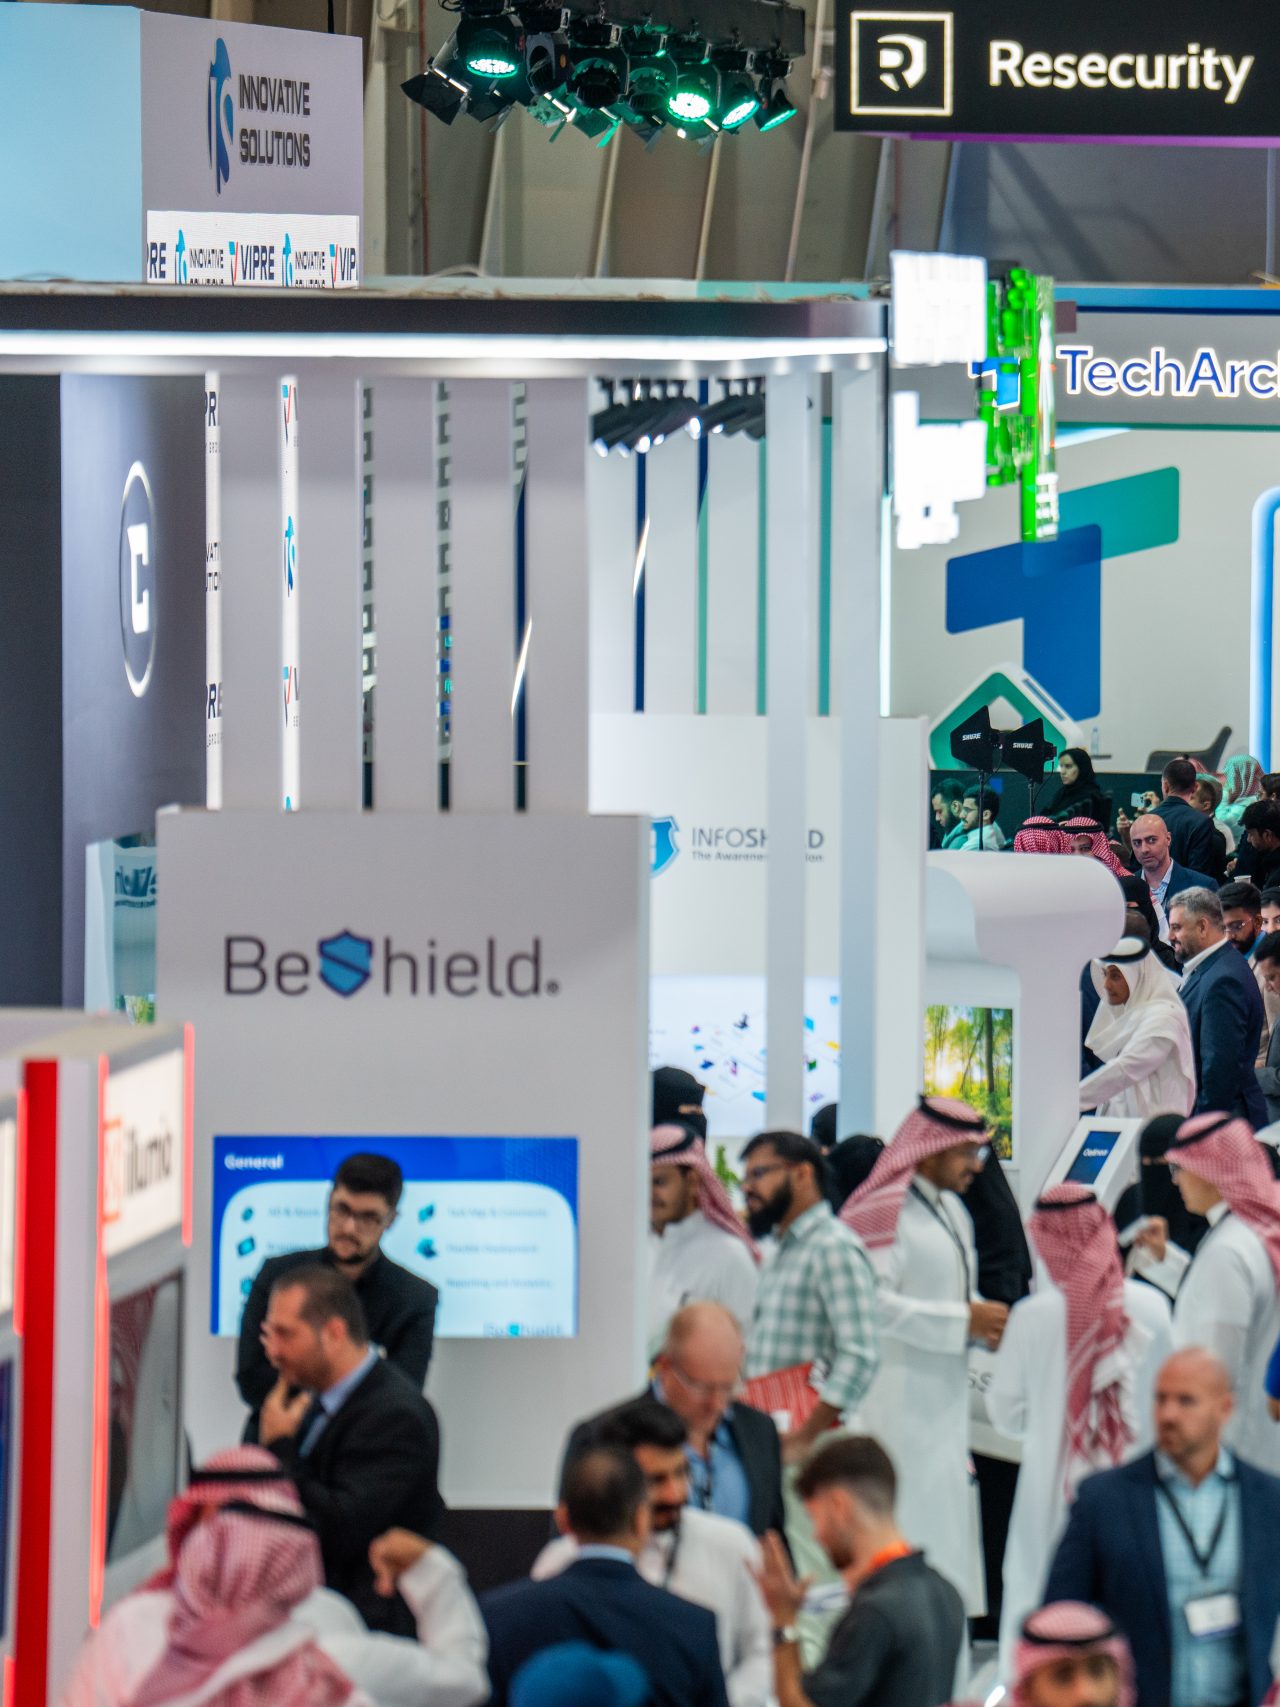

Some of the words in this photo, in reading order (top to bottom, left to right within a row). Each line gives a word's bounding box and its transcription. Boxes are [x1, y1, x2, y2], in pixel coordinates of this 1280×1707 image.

[989, 40, 1255, 104] Resecurity
[239, 74, 311, 116] INNOVATIVE
[240, 128, 311, 167] SOLUTIONS
[240, 245, 275, 280] VIPRE
[962, 733, 982, 741] SHURE
[224, 1153, 284, 1170] General
